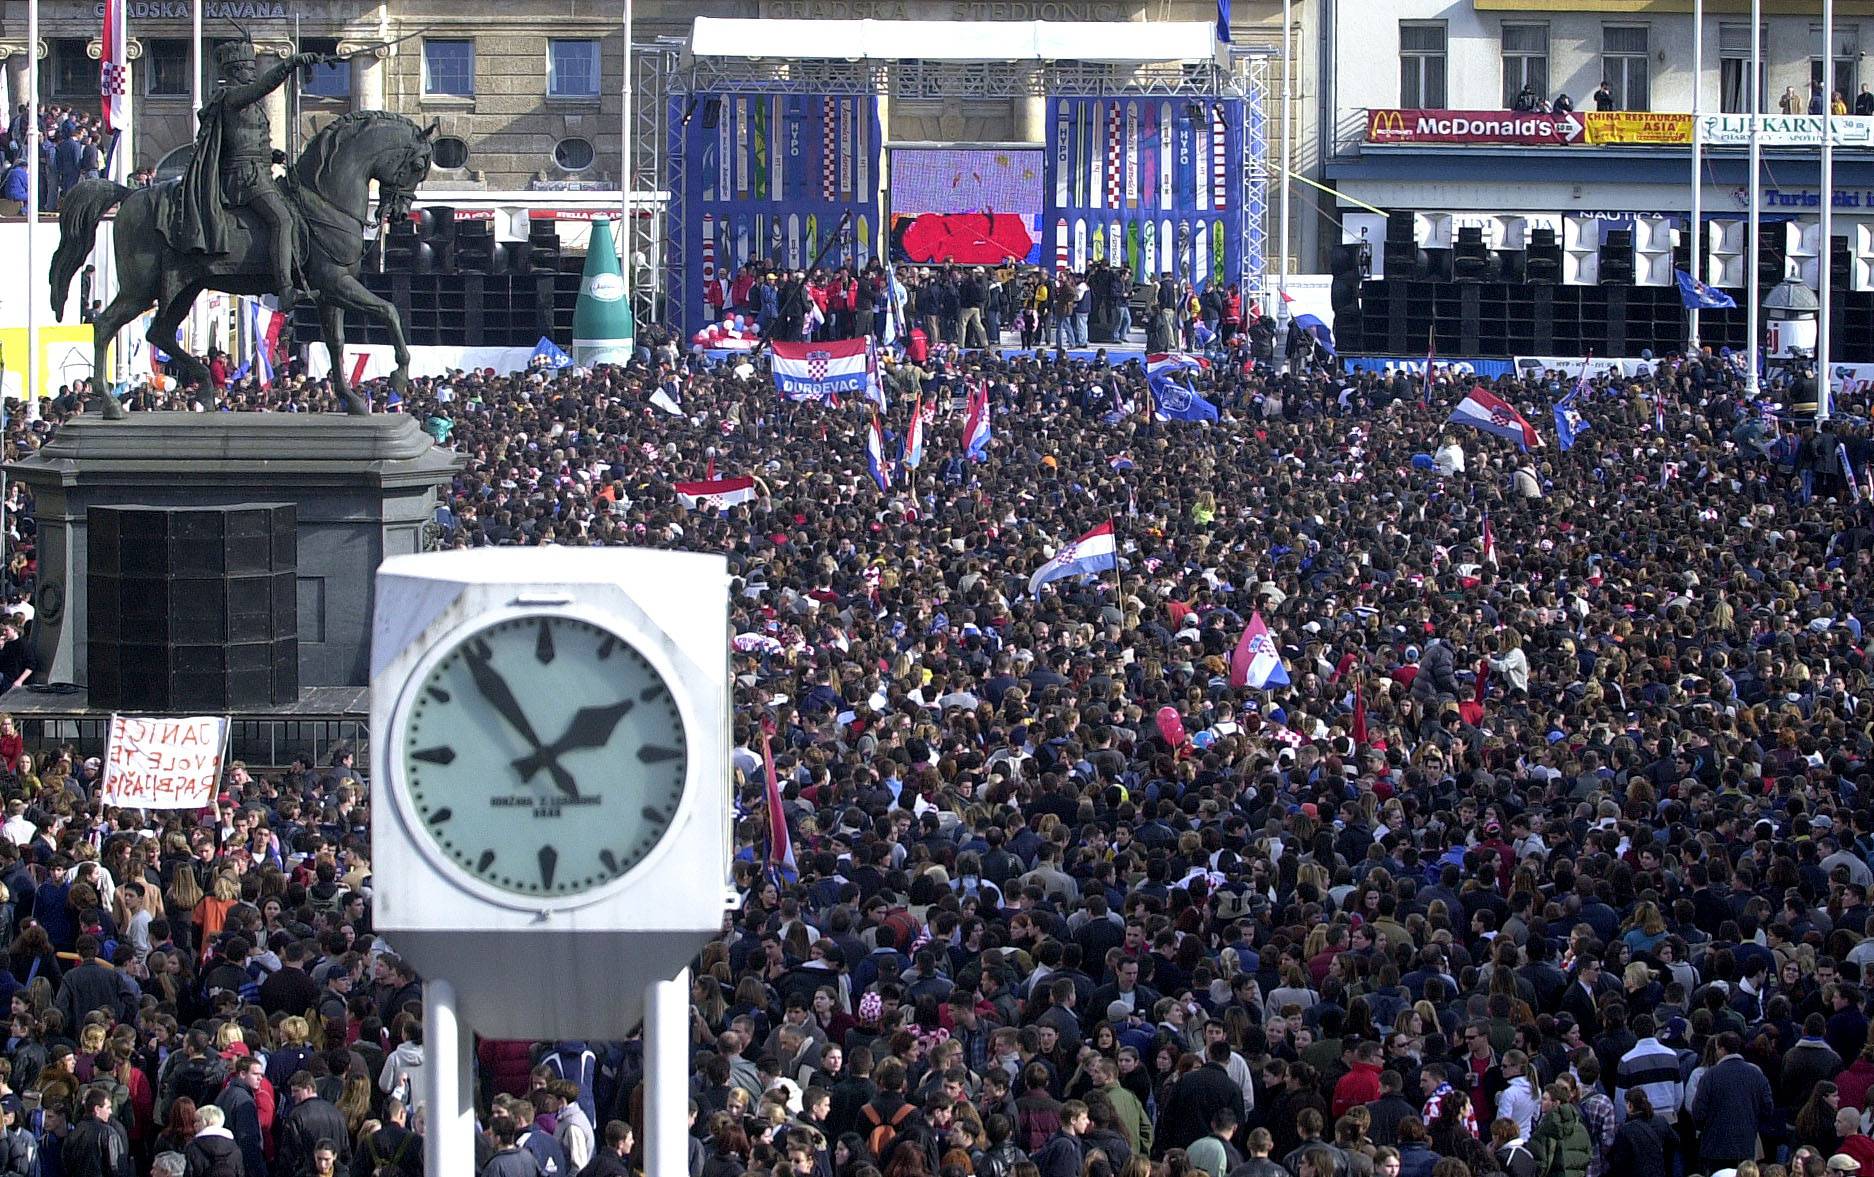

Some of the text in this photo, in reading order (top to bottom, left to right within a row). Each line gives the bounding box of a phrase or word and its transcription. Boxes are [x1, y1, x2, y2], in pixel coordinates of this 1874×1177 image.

[95, 2, 285, 18] GADSKA KAVANA
[767, 2, 906, 18] GRADSKA
[1588, 113, 1692, 122] CHINA RESTAURANT
[1722, 117, 1838, 133] LJKARNA
[1416, 117, 1552, 136] McDonald's
[1643, 122, 1677, 131] ASIA
[790, 122, 800, 156] HYPO
[1059, 128, 1067, 162] HYPO
[1180, 131, 1189, 165] HYPO
